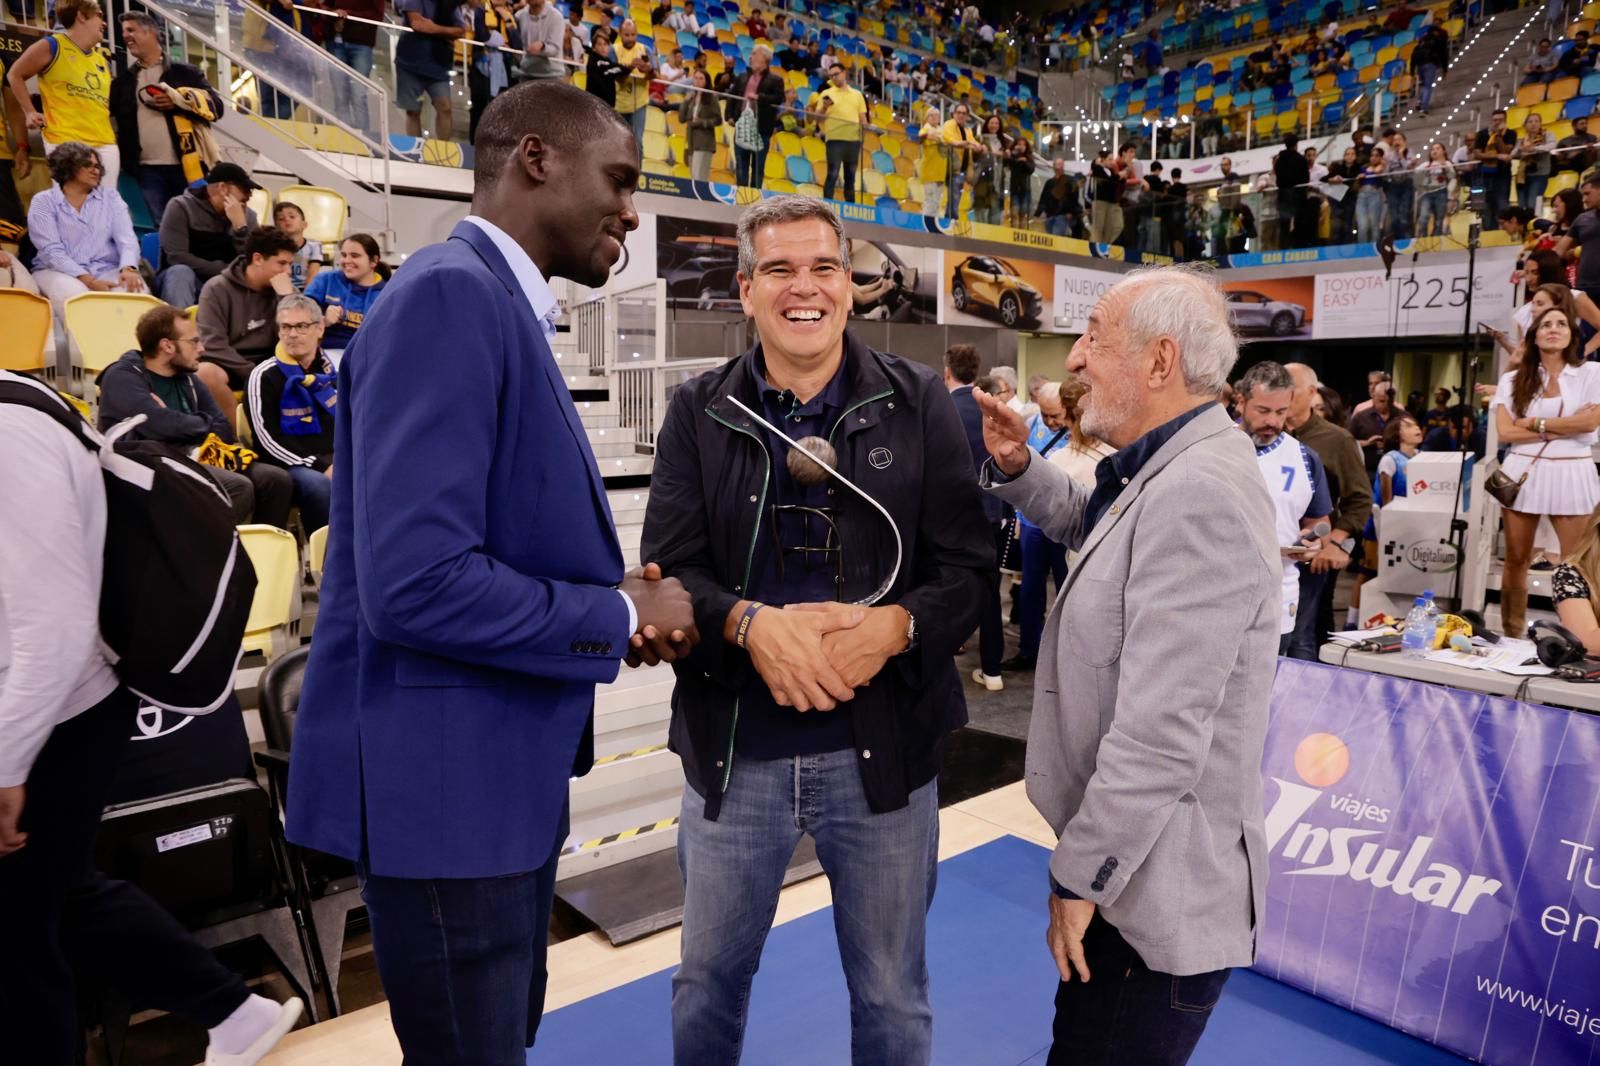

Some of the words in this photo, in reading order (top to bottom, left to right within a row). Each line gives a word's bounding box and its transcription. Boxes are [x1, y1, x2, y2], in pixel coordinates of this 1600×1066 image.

[843, 204, 876, 221] CANARIA
[1013, 231, 1028, 243] GRAN
[1030, 233, 1054, 247] CANARIA
[1284, 249, 1319, 262] CANARIA
[1064, 278, 1106, 297] NUEVO
[1322, 276, 1384, 292] TOYOTA
[1401, 276, 1469, 309] 225
[1323, 293, 1360, 307] EASY
[1281, 465, 1296, 492] 7
[1330, 793, 1391, 823] viajes
